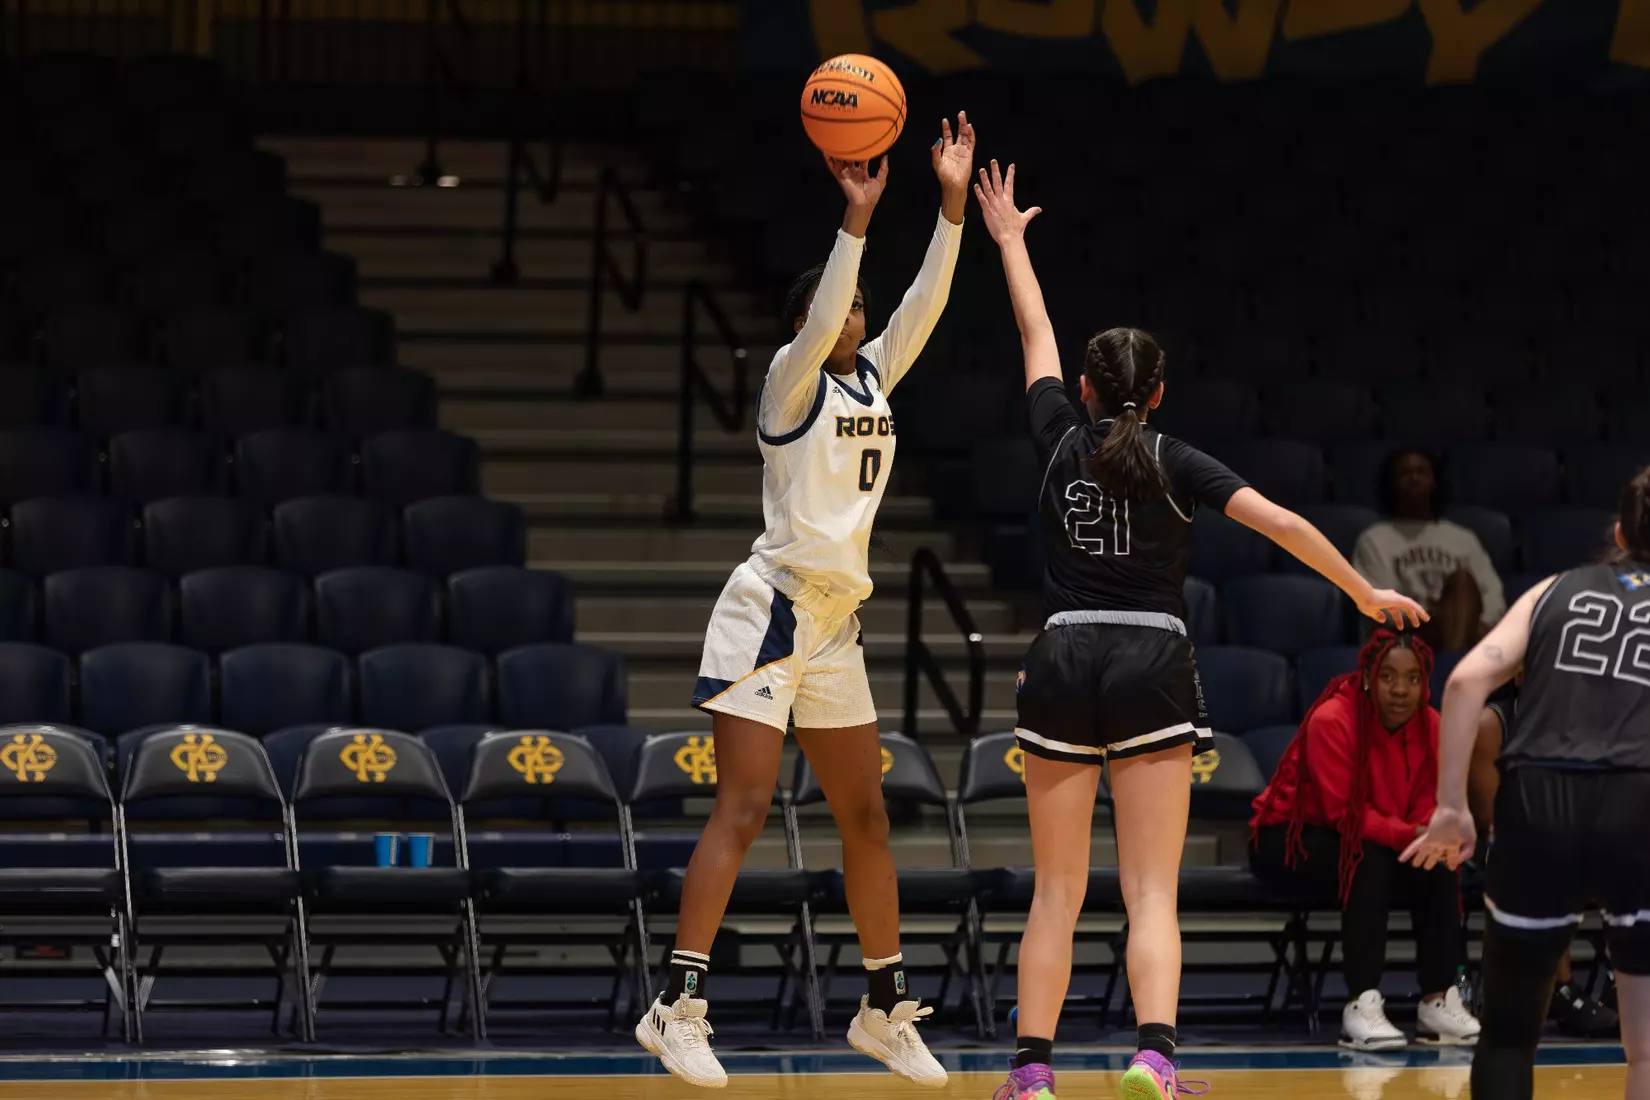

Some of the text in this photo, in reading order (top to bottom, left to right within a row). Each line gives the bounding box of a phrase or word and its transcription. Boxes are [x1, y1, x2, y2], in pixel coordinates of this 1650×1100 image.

[809, 88, 858, 109] NCAA
[859, 448, 881, 491] 0
[1064, 479, 1131, 555] 21
[1554, 589, 1650, 687] 22
